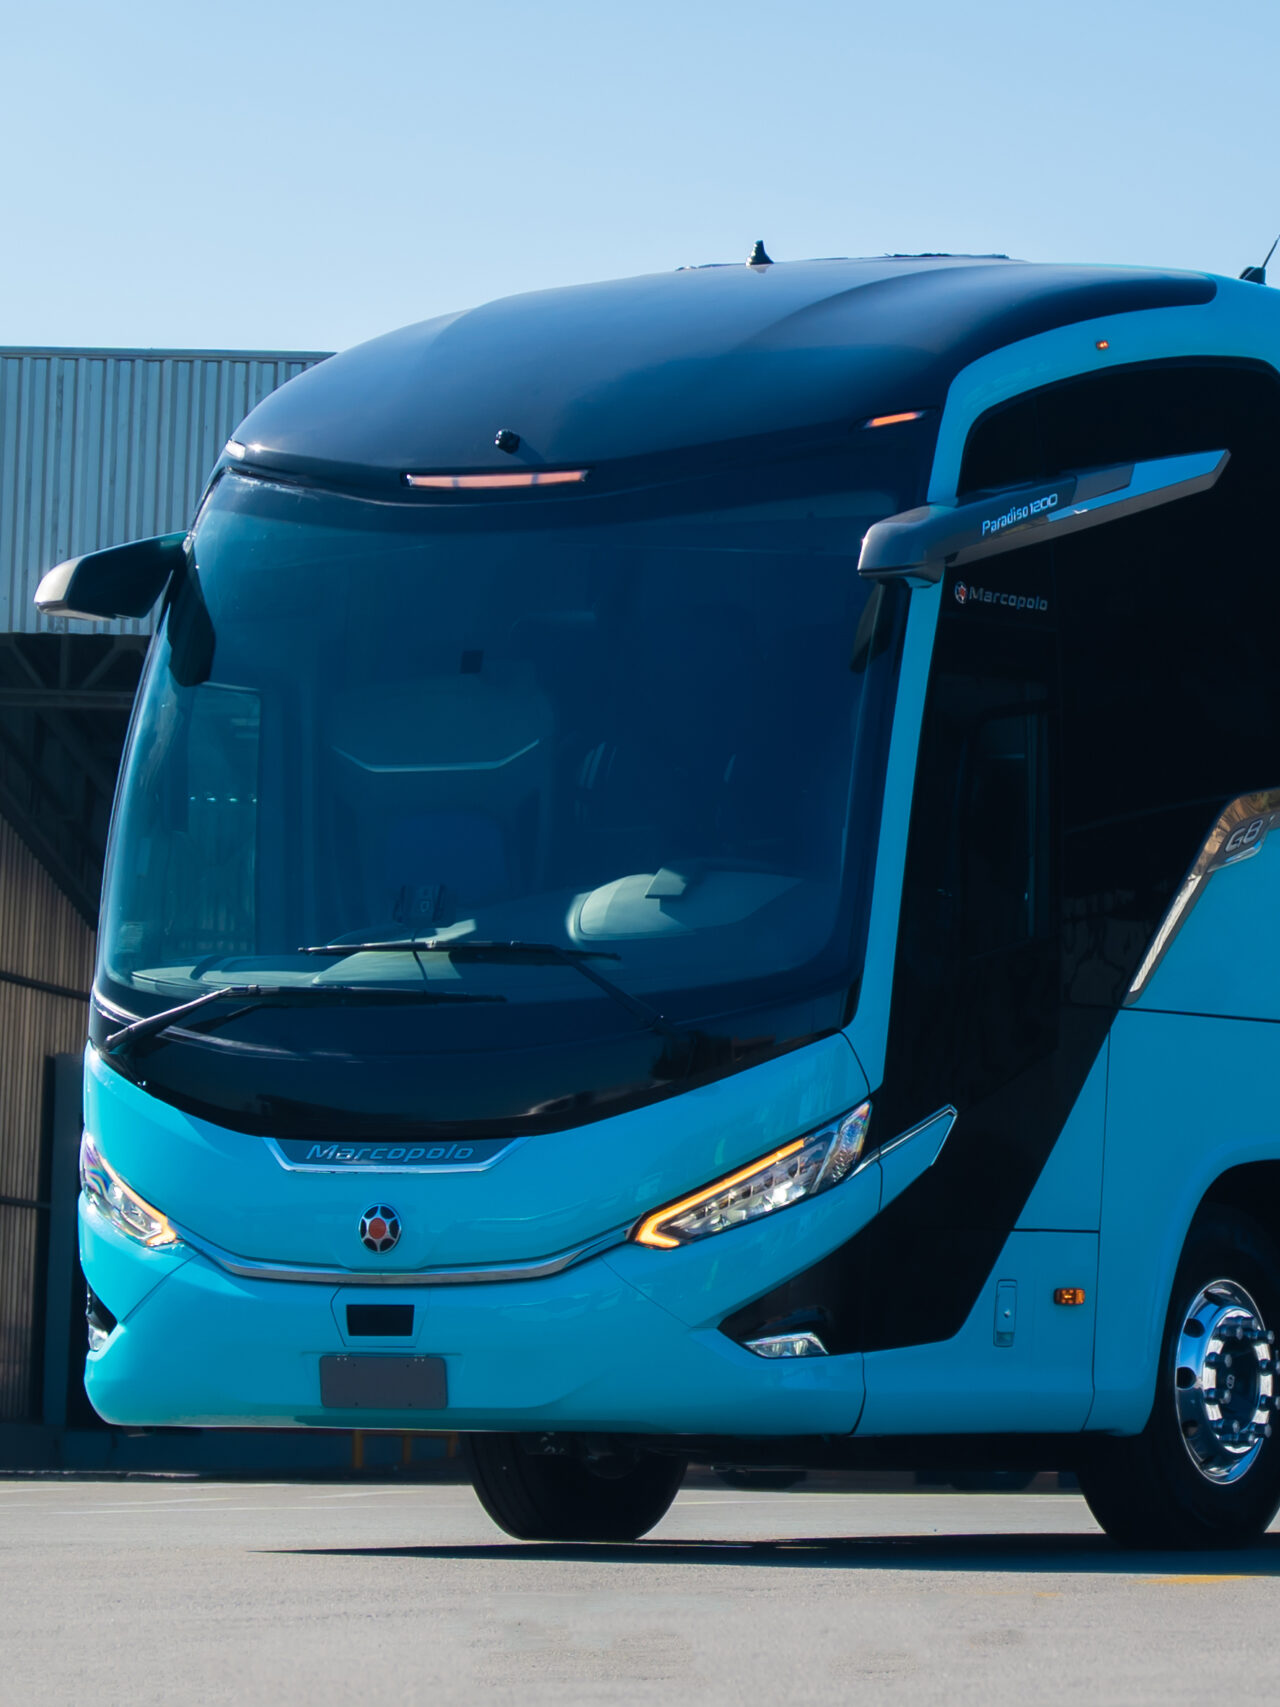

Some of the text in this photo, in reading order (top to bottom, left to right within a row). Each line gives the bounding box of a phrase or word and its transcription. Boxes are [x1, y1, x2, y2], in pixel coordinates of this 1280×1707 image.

[982, 493, 1058, 536] Paradiso 1200
[969, 585, 1048, 611] Marcopolo
[1225, 819, 1264, 852] G8
[306, 1144, 474, 1162] Marcopolo
